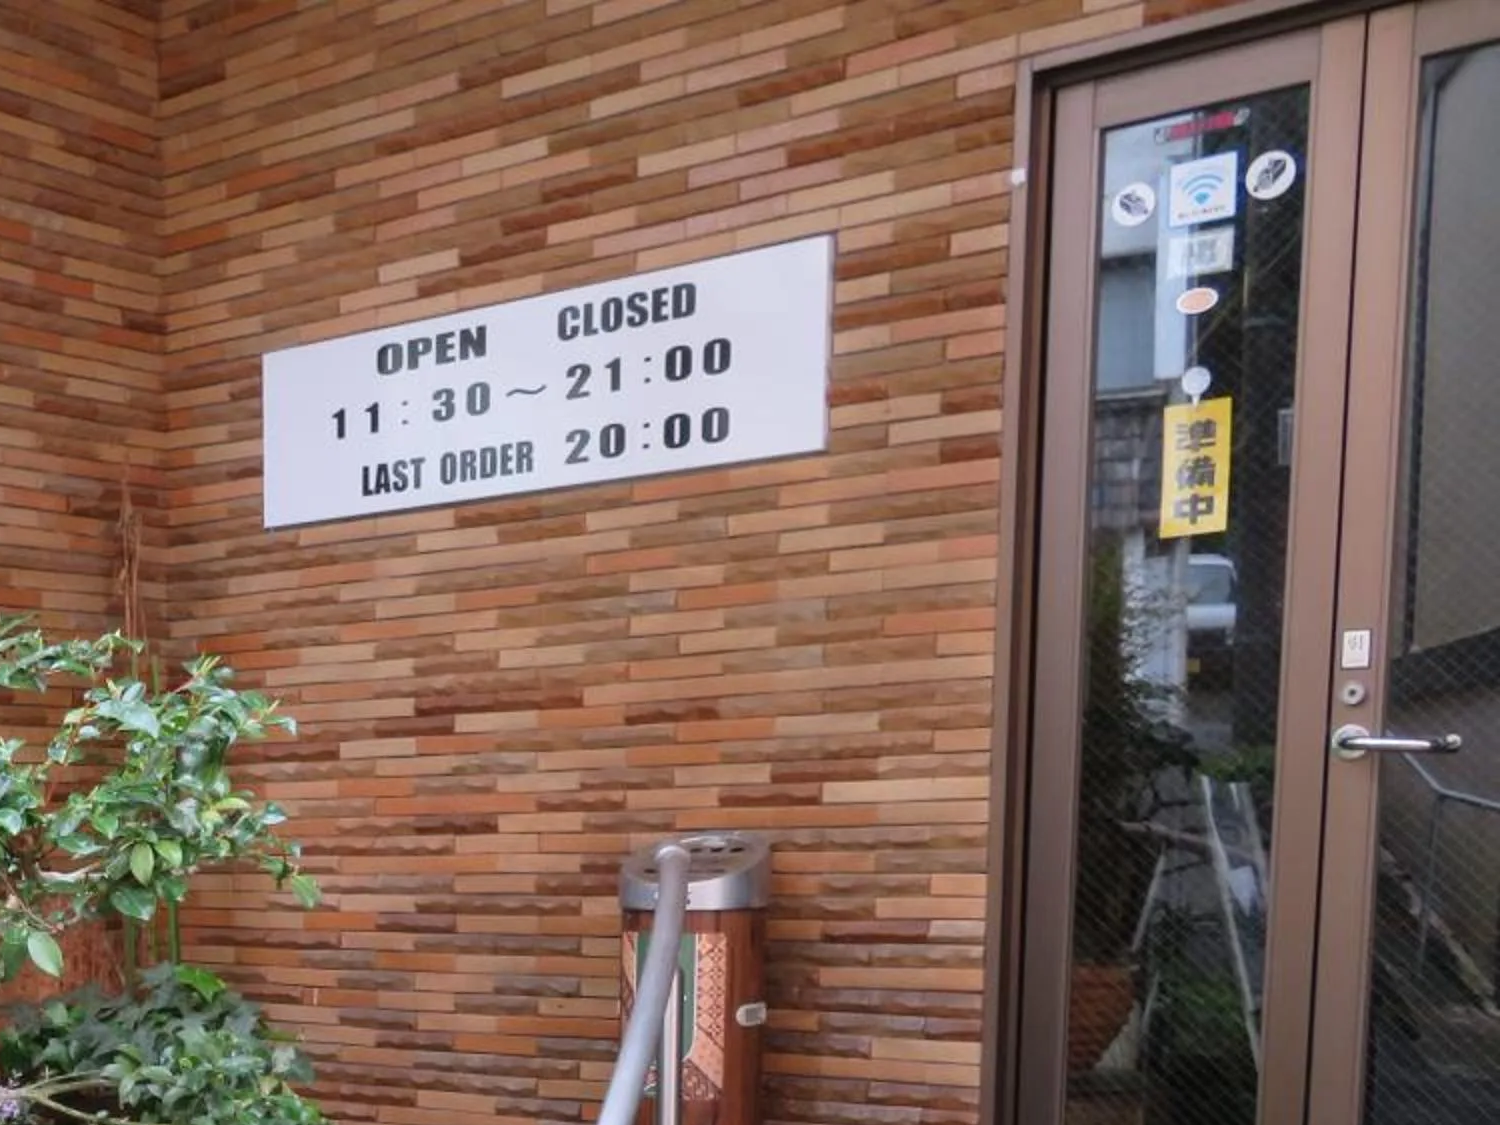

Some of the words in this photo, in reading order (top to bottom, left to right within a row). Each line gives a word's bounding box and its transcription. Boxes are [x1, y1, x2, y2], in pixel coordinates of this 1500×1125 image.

[376, 324, 488, 376] OPEN
[557, 282, 697, 342] CLOSED
[361, 457, 426, 497] LAST
[440, 441, 534, 486] ORDER
[565, 407, 730, 465] 20:00
[1174, 418, 1217, 525] 準備中
